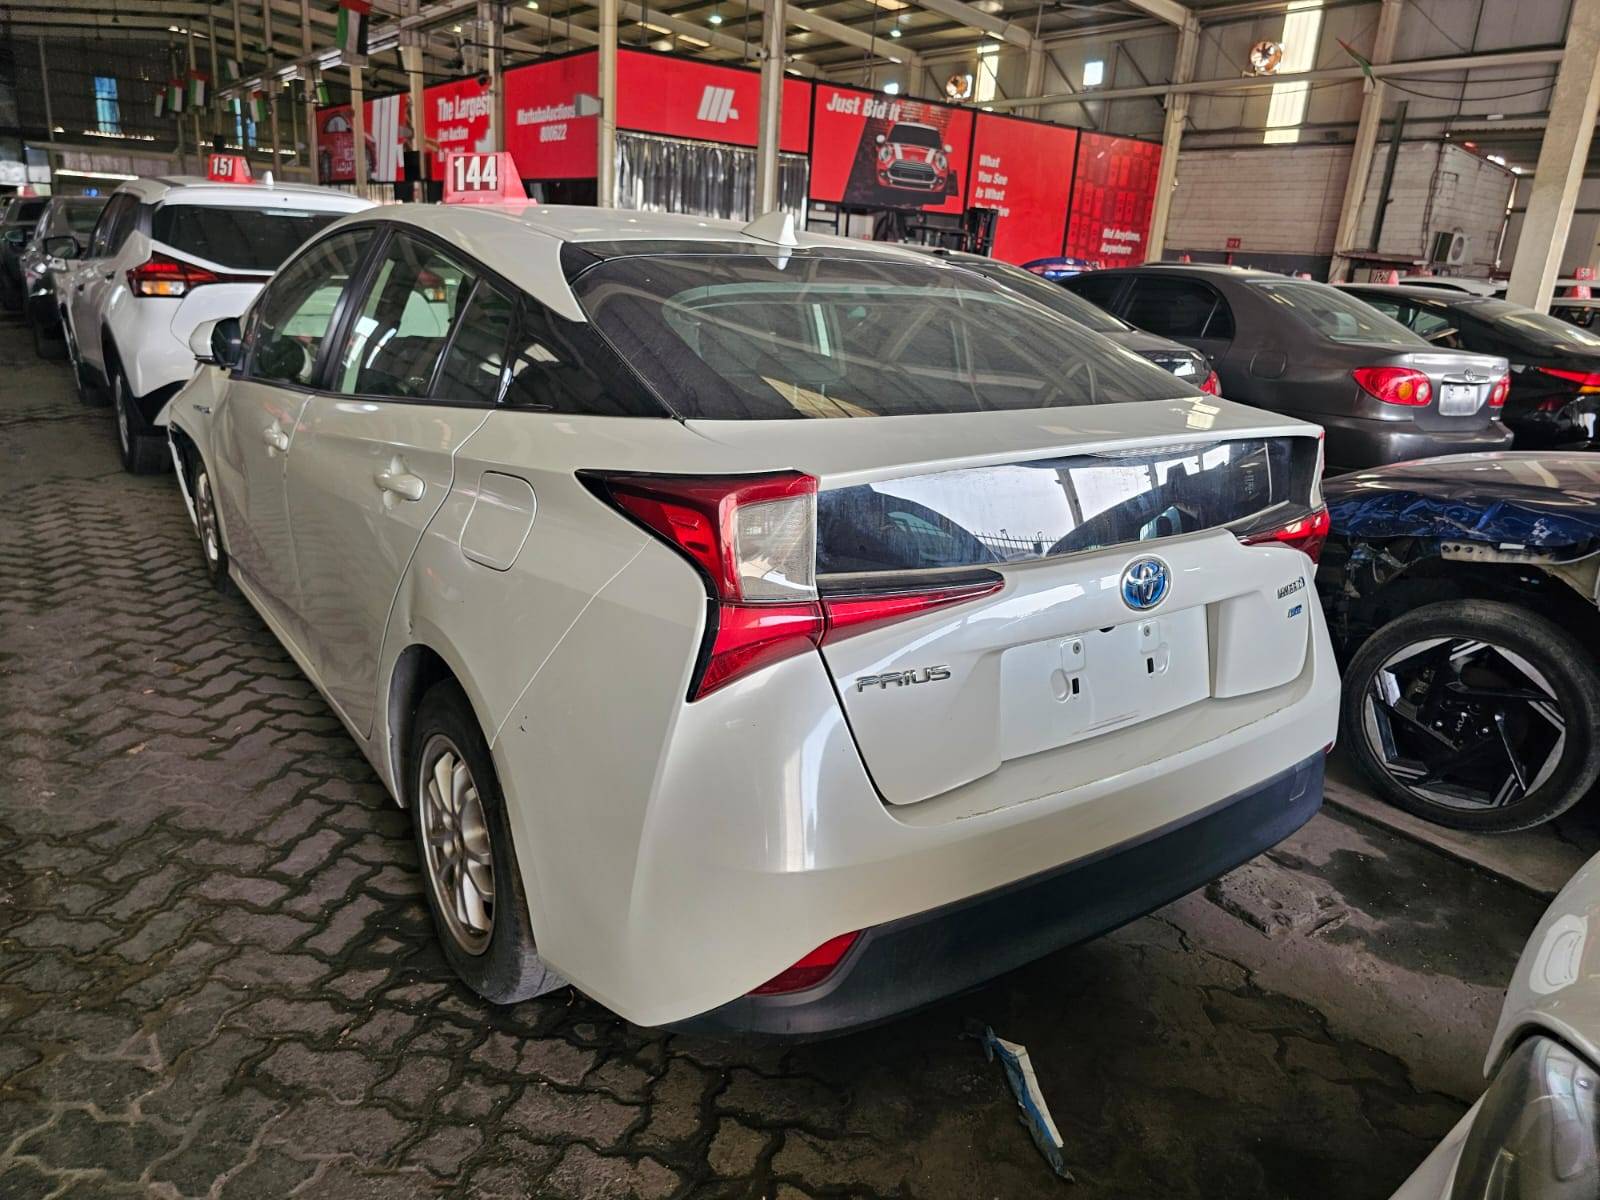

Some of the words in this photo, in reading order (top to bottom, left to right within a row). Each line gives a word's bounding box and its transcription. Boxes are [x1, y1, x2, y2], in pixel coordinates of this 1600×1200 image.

[437, 97, 454, 122] The
[826, 92, 861, 115] Just
[862, 98, 886, 119] Bid
[889, 103, 901, 122] It
[212, 156, 234, 176] 151
[454, 155, 498, 191] 144
[993, 172, 1009, 186] See
[856, 665, 951, 692] PRIUS
